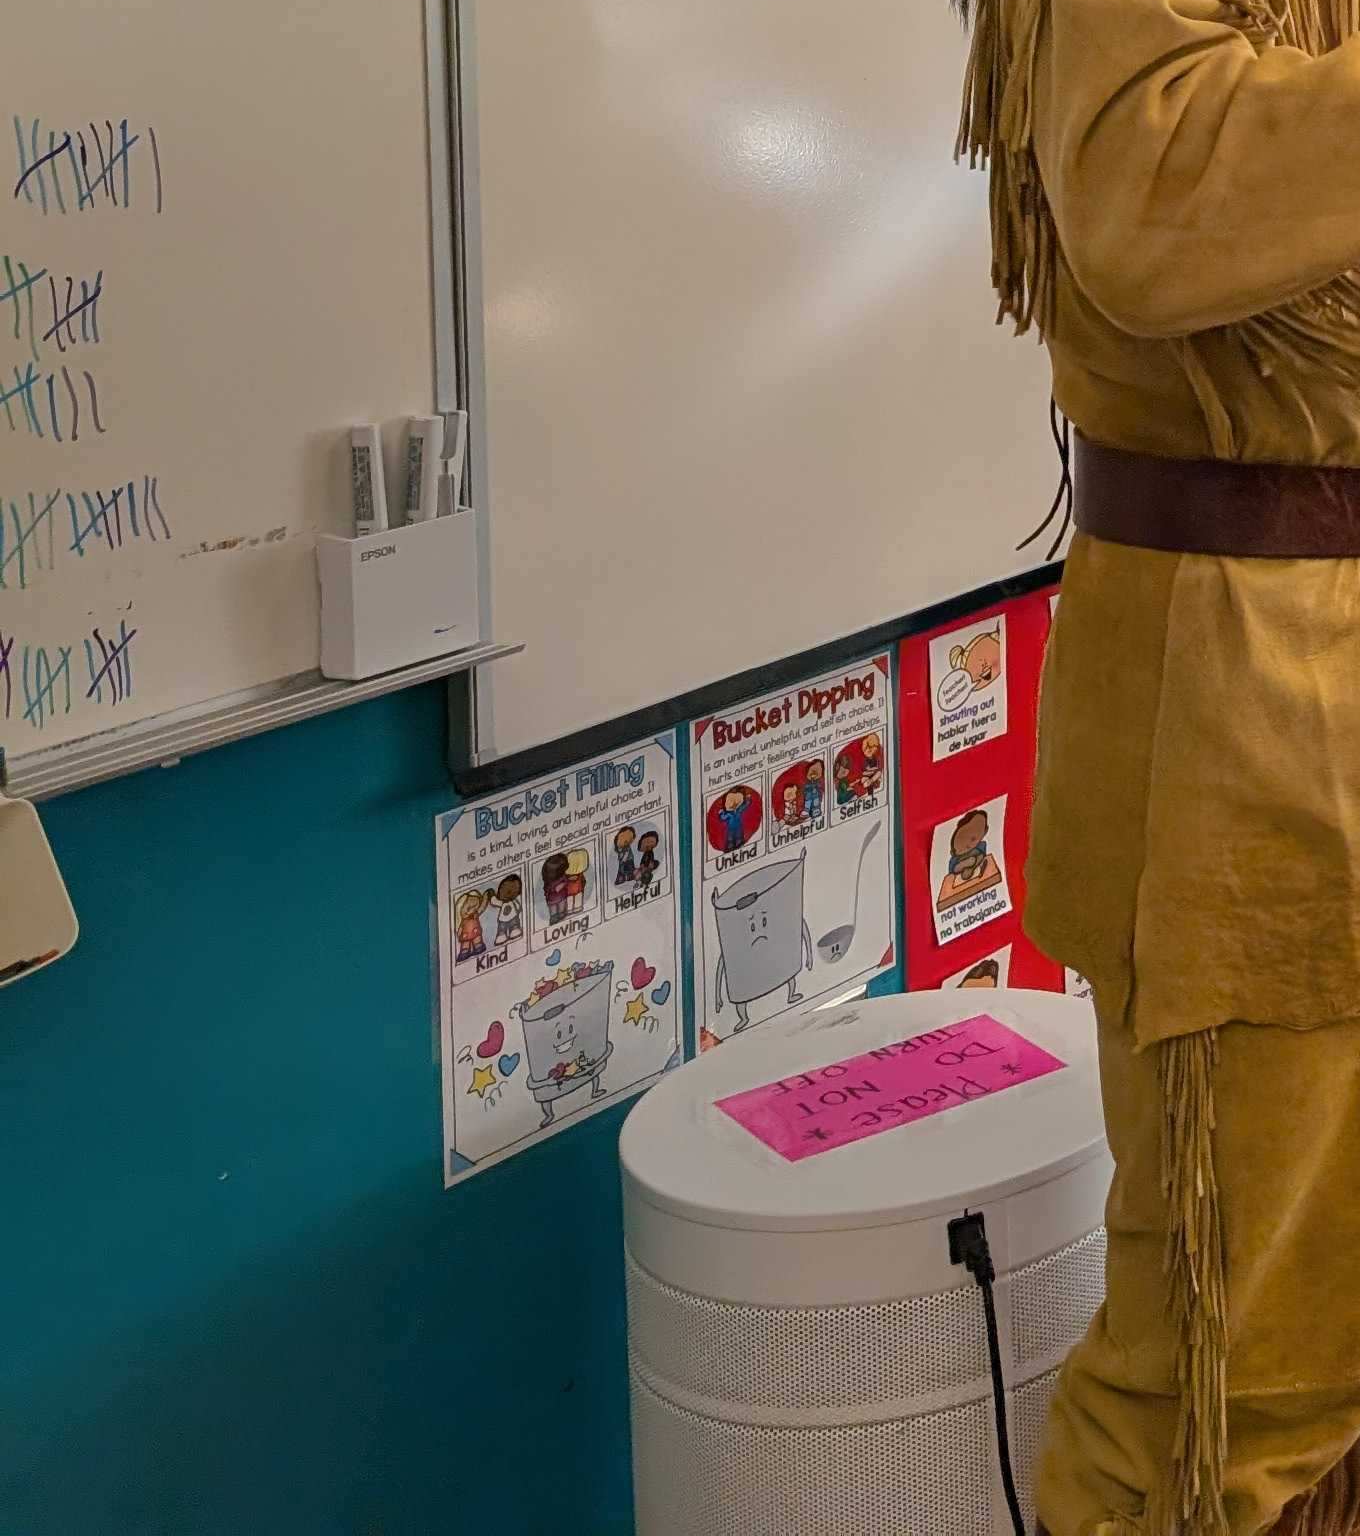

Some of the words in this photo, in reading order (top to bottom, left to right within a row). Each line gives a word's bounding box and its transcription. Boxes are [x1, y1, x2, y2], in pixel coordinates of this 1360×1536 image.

[359, 544, 397, 563] EPSON
[712, 695, 793, 751] Bucket
[797, 671, 876, 720] Dipping
[937, 723, 970, 744] hablar
[971, 711, 997, 730] fuera
[939, 702, 979, 728] shouting
[980, 695, 995, 712] out
[713, 757, 726, 770] an
[802, 720, 818, 737] and
[820, 710, 848, 729] selfish
[949, 740, 961, 754] de
[963, 729, 988, 749] lugar
[708, 770, 733, 787] hurts
[766, 744, 801, 767] feelings
[801, 738, 817, 753] and
[818, 731, 833, 745] our
[474, 777, 571, 841] Bucket
[575, 754, 646, 802] Filling
[838, 794, 879, 822] Selfish
[466, 849, 476, 863] is
[479, 847, 487, 859] a
[552, 812, 573, 831] and
[574, 795, 610, 822] helpful
[771, 816, 826, 848] Unhelpful
[457, 863, 494, 885] makes
[495, 847, 533, 870] others
[534, 838, 553, 856] feel
[554, 820, 591, 849] special
[592, 814, 612, 833] and
[714, 842, 758, 872] Unkind
[613, 880, 662, 914] Helpful
[940, 908, 957, 924] not
[958, 887, 998, 914] working
[543, 915, 590, 945] Loving
[939, 925, 953, 941] no
[954, 899, 1008, 933] trabajando
[475, 946, 509, 974] Kind
[933, 1040, 1007, 1067] DO
[796, 1078, 882, 1118] NOT
[849, 1074, 994, 1129] Please
